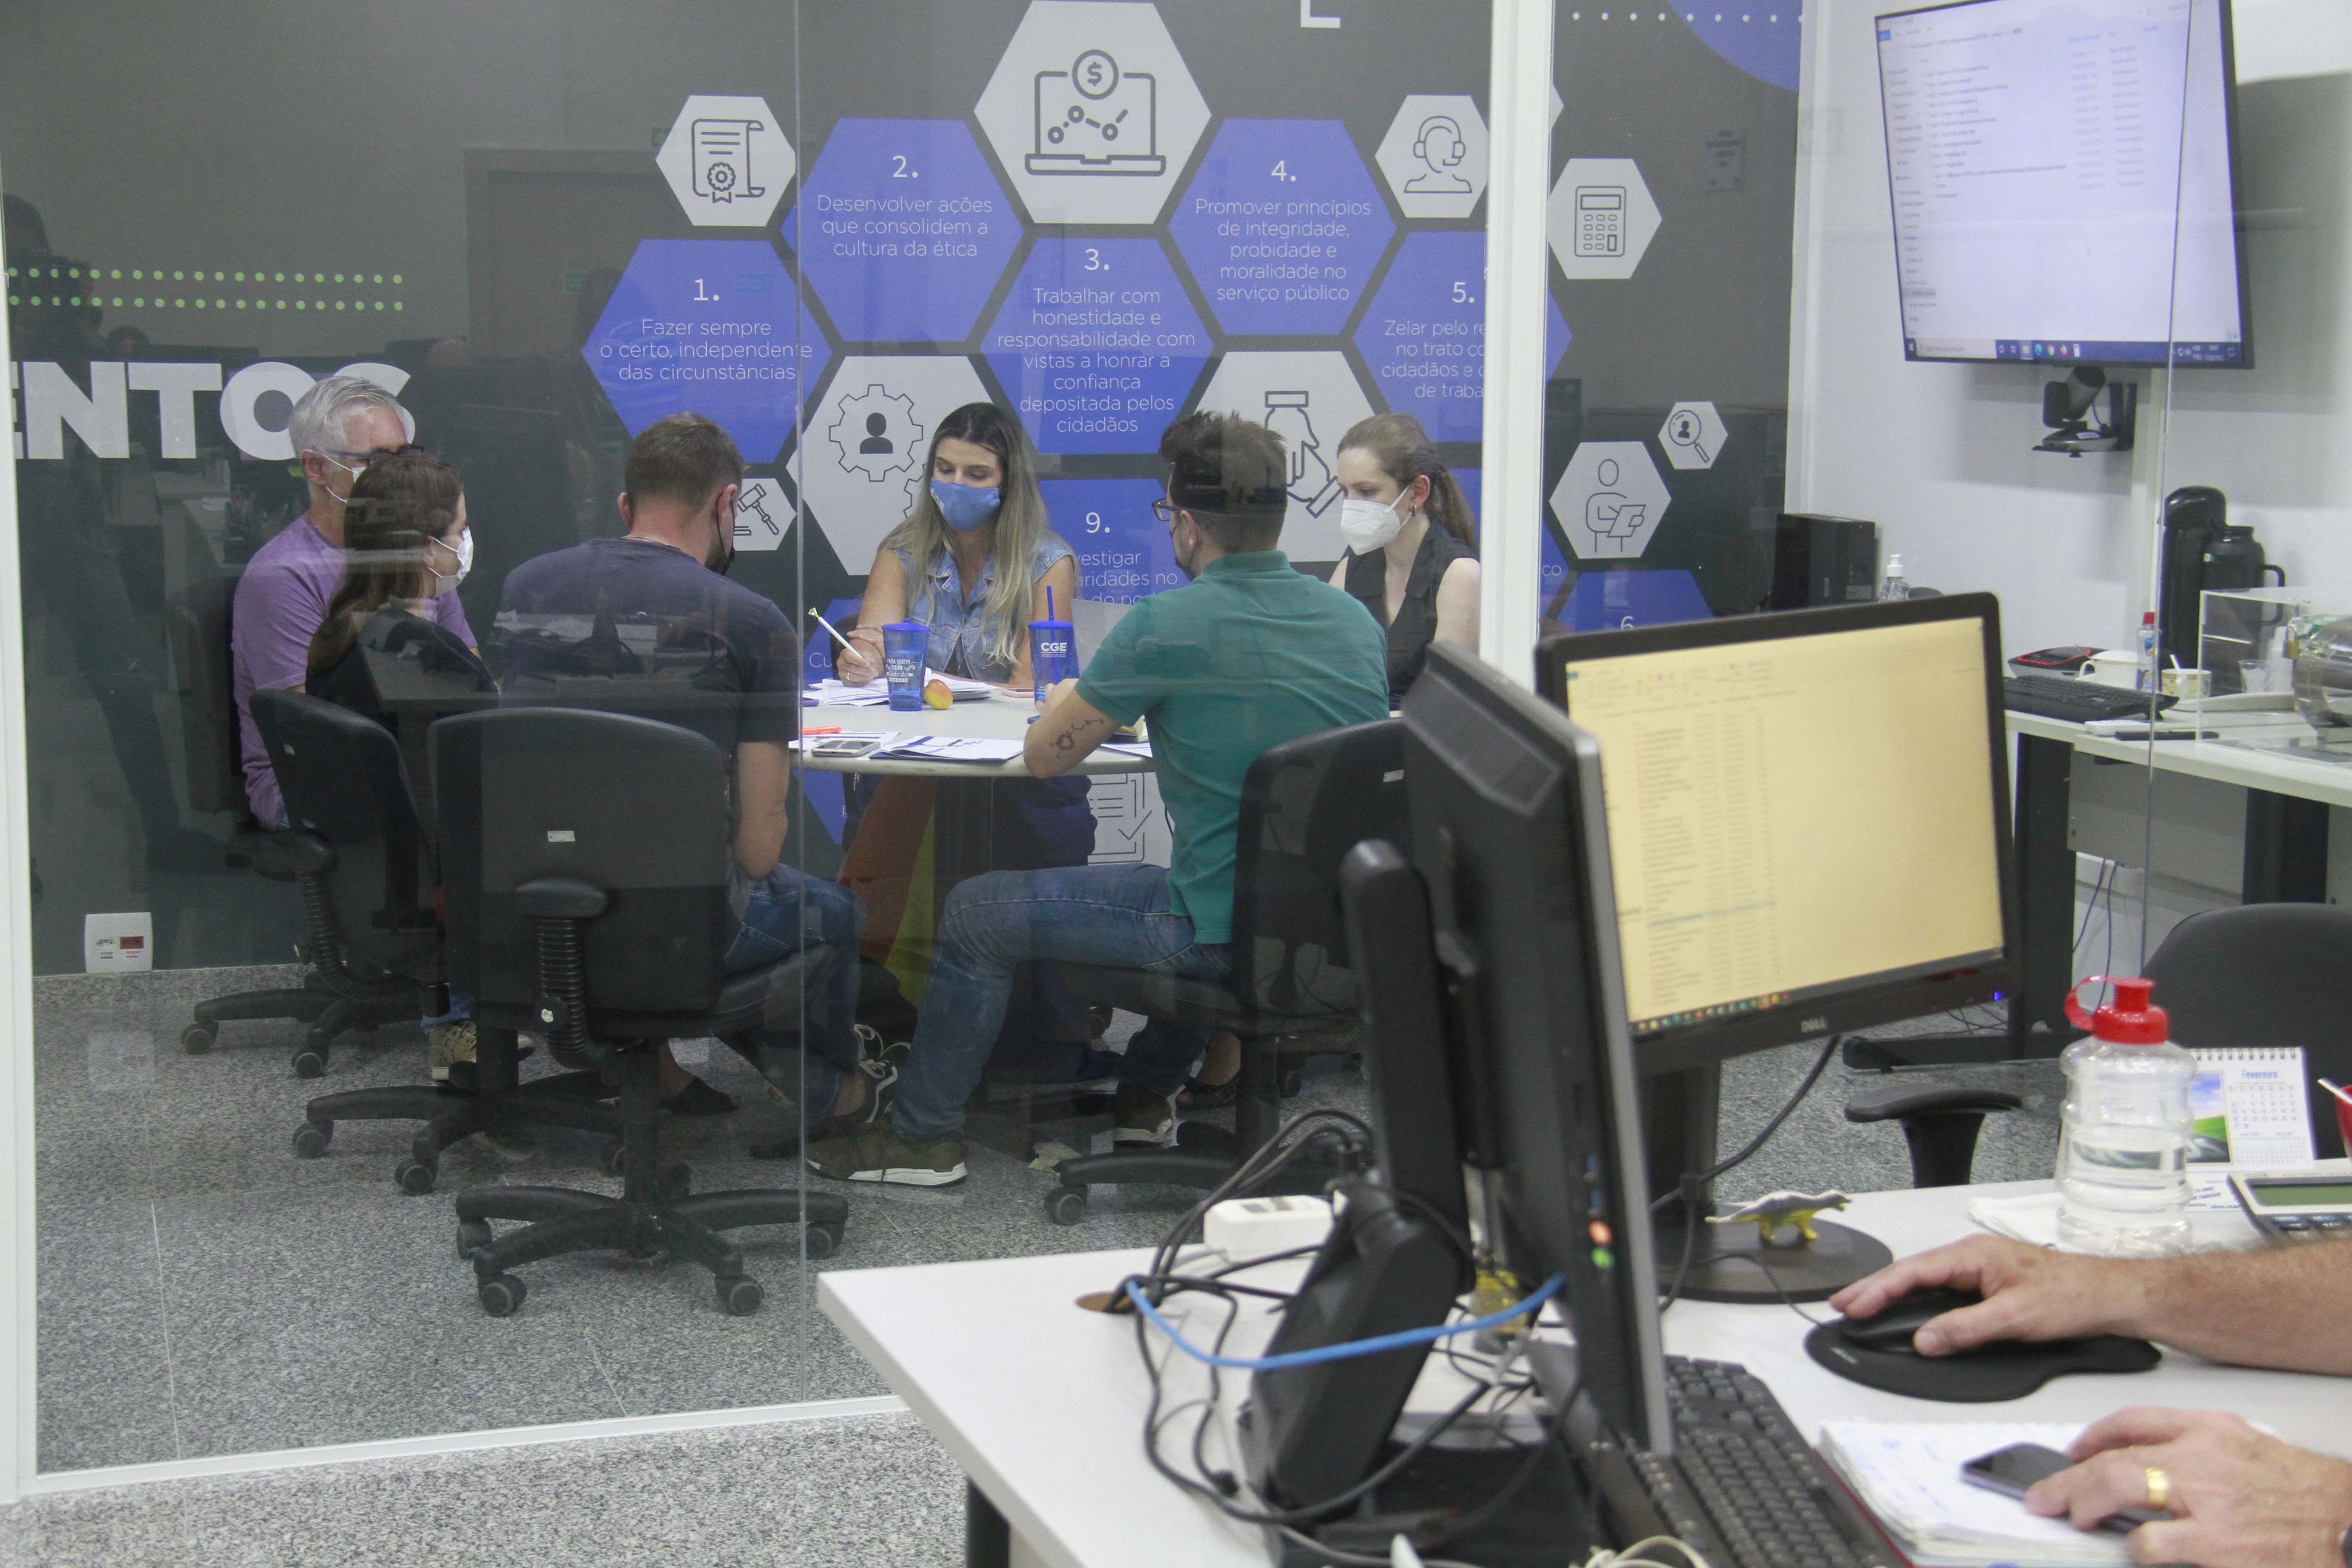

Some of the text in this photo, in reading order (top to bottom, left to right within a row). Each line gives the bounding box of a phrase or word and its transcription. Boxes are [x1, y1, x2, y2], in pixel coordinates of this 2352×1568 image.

[893, 155, 918, 178] 2.
[1271, 160, 1296, 181] 4.
[818, 195, 992, 215] Desenvolver ações
[1196, 198, 1371, 217] Promover princípios
[822, 218, 988, 236] que consolidem a
[1218, 220, 1349, 239] de integridade,
[834, 240, 977, 257] cultura da ética
[1230, 242, 1337, 260] probidade e
[1085, 249, 1109, 270] 3.
[1220, 263, 1347, 279] moralidade no
[694, 279, 719, 301] 1.
[1033, 288, 1160, 304] Trabalhar com
[1217, 284, 1349, 303] serviço público
[1452, 281, 1475, 303] 5.
[1033, 309, 1161, 325] honestidade e
[641, 319, 771, 338] Fazer sempre
[1385, 320, 1426, 335] Zelar
[1432, 320, 1468, 338] pelo
[998, 331, 1195, 349] responsabilidade com
[1396, 345, 1417, 356] no
[1423, 341, 1463, 356] trato
[600, 345, 612, 358] o
[619, 343, 672, 358] certo,
[1024, 353, 1170, 368] vistas a honrar a
[1382, 362, 1459, 377] cidadãos
[1464, 365, 1473, 377] e
[619, 363, 796, 380] das circunstâncias
[1054, 373, 1140, 392] confiança
[1415, 382, 1436, 398] de
[1020, 395, 1174, 413] depositada pelos
[1057, 416, 1138, 432] cidadãos
[1086, 512, 1111, 534] 9.
[1156, 573, 1177, 585] no
[1041, 642, 1067, 652] CGE
[2241, 1069, 2278, 1079] Fevereiro
